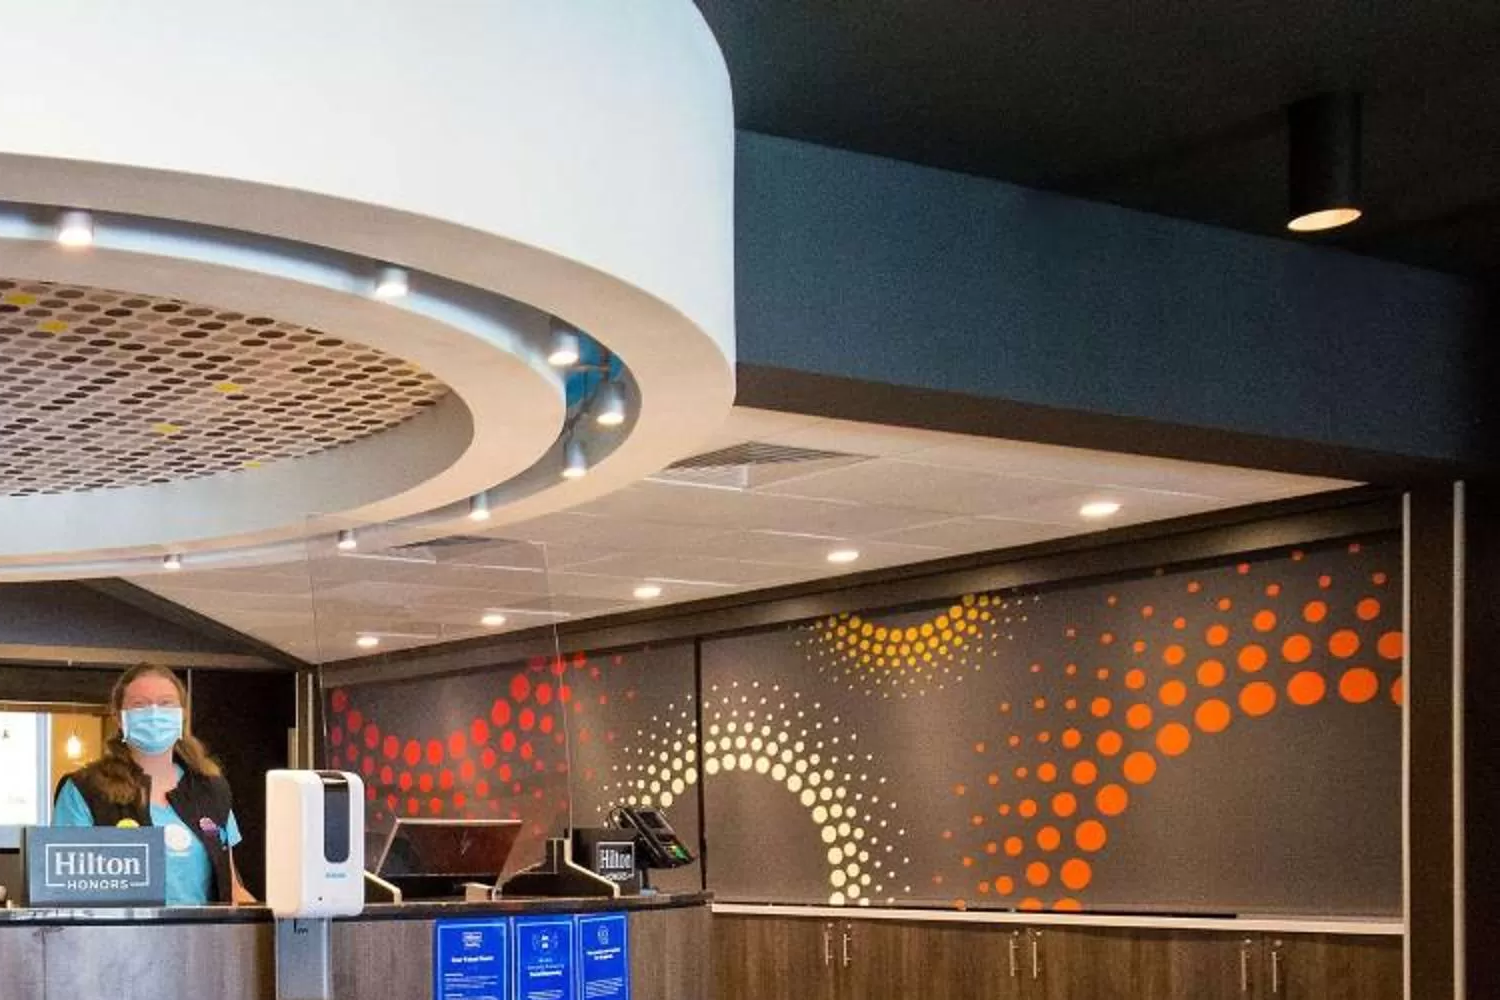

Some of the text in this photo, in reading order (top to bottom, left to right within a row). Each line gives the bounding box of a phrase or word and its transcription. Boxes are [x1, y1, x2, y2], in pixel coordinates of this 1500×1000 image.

[55, 852, 141, 875] Hilton
[599, 849, 632, 869] Hilton
[67, 880, 129, 889] HONORS
